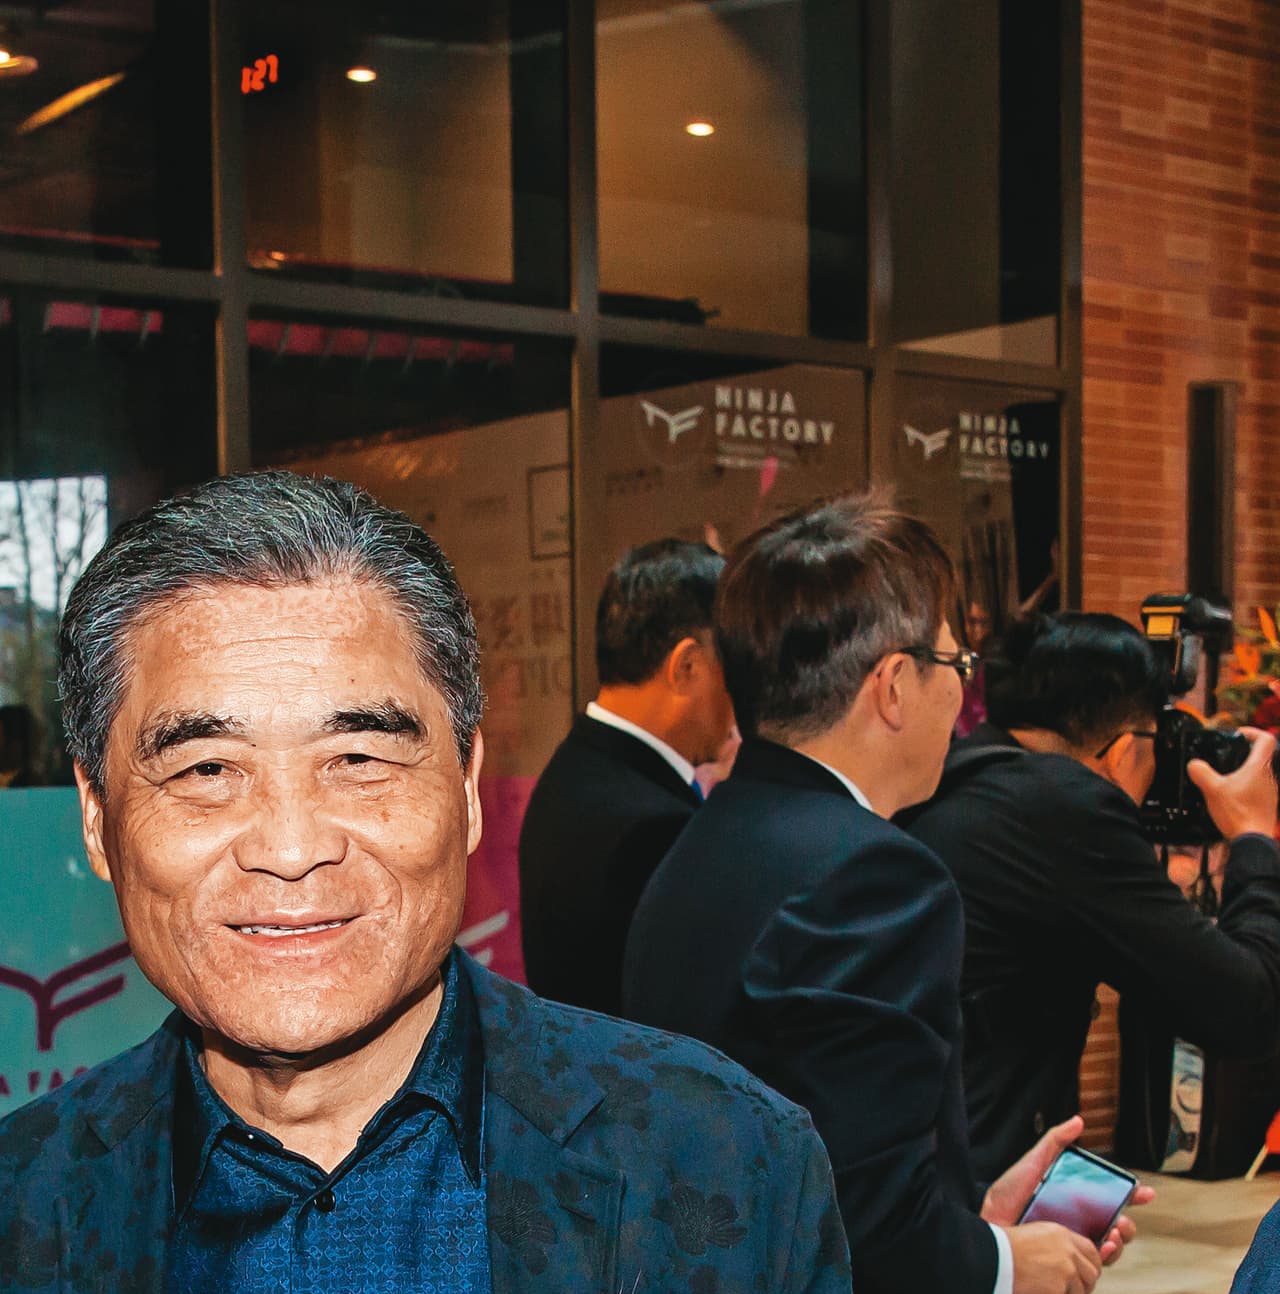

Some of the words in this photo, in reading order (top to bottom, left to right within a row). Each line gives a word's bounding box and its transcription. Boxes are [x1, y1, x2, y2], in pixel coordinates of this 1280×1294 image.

[715, 384, 796, 413] NINJA
[715, 411, 835, 445] FACTORY
[958, 411, 1021, 434] NINJA
[958, 432, 1049, 458] FACTORY
